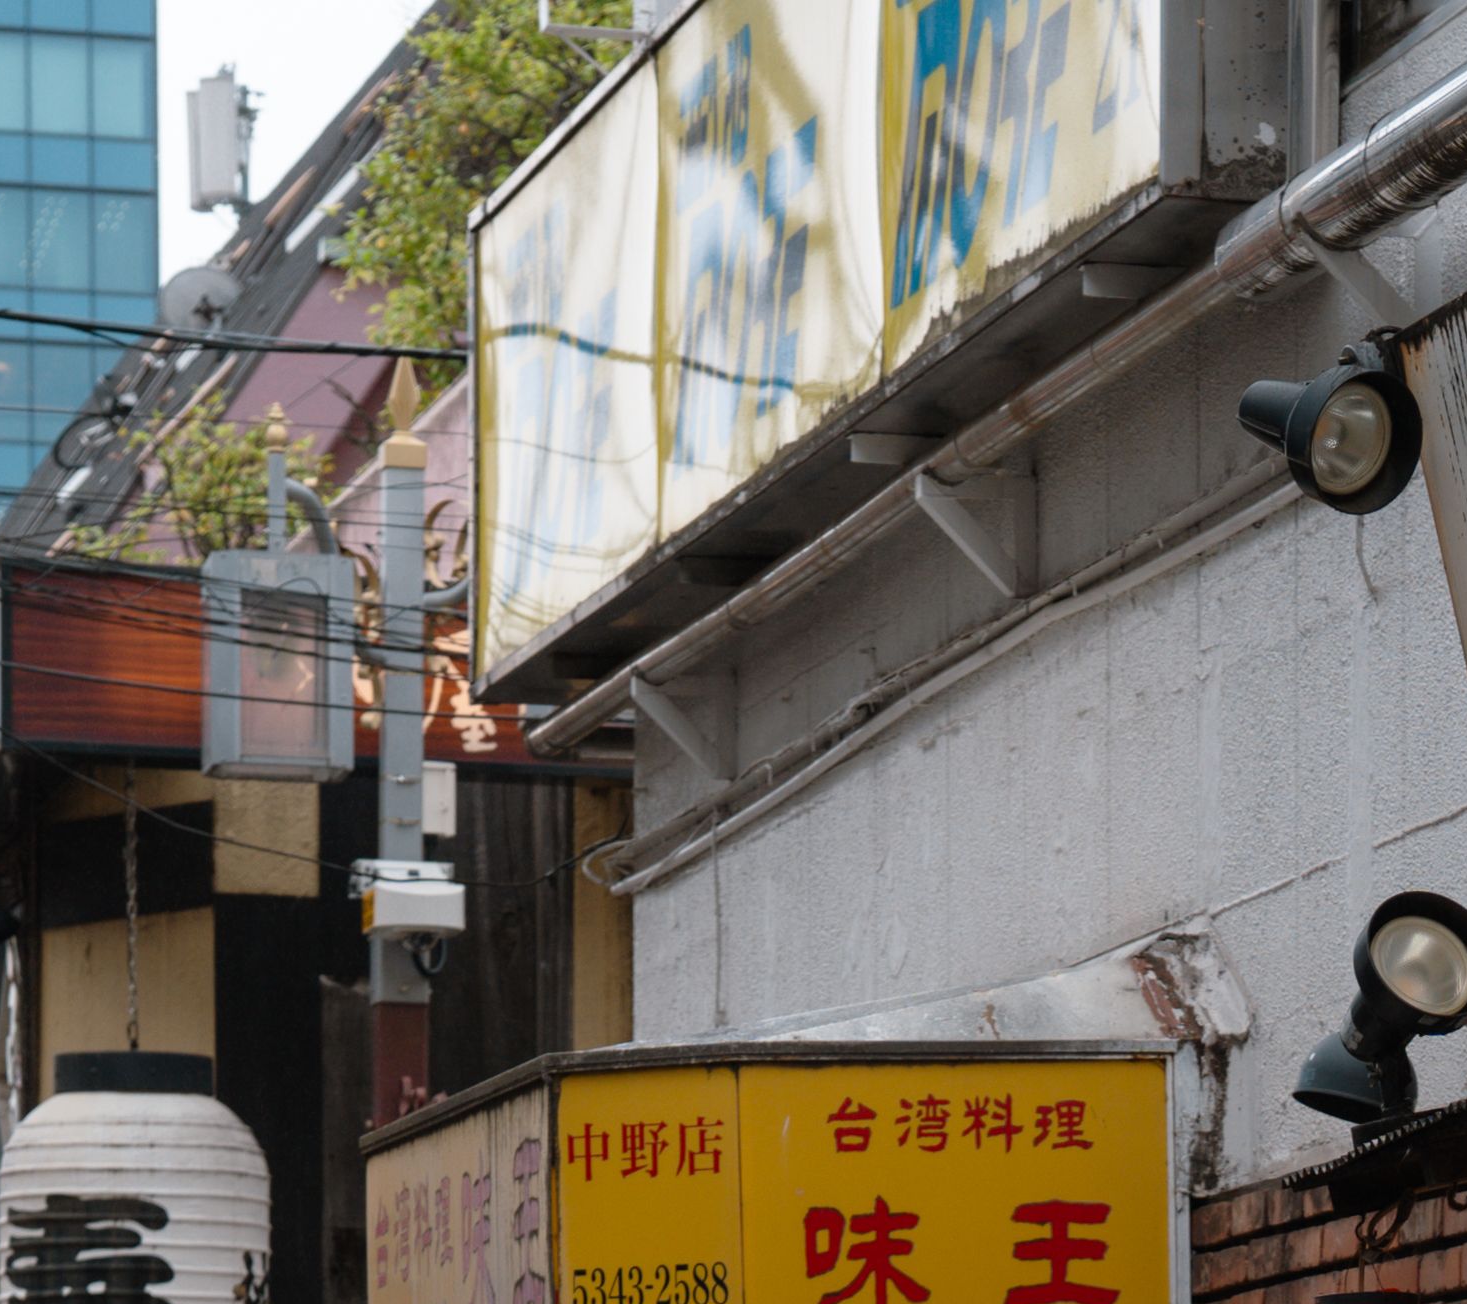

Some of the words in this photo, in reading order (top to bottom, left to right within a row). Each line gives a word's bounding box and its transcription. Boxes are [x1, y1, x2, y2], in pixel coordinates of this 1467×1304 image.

[566, 1115, 725, 1182] 中野店
[827, 1093, 1095, 1154] 台湾料理
[375, 1172, 454, 1291] 台湾料理
